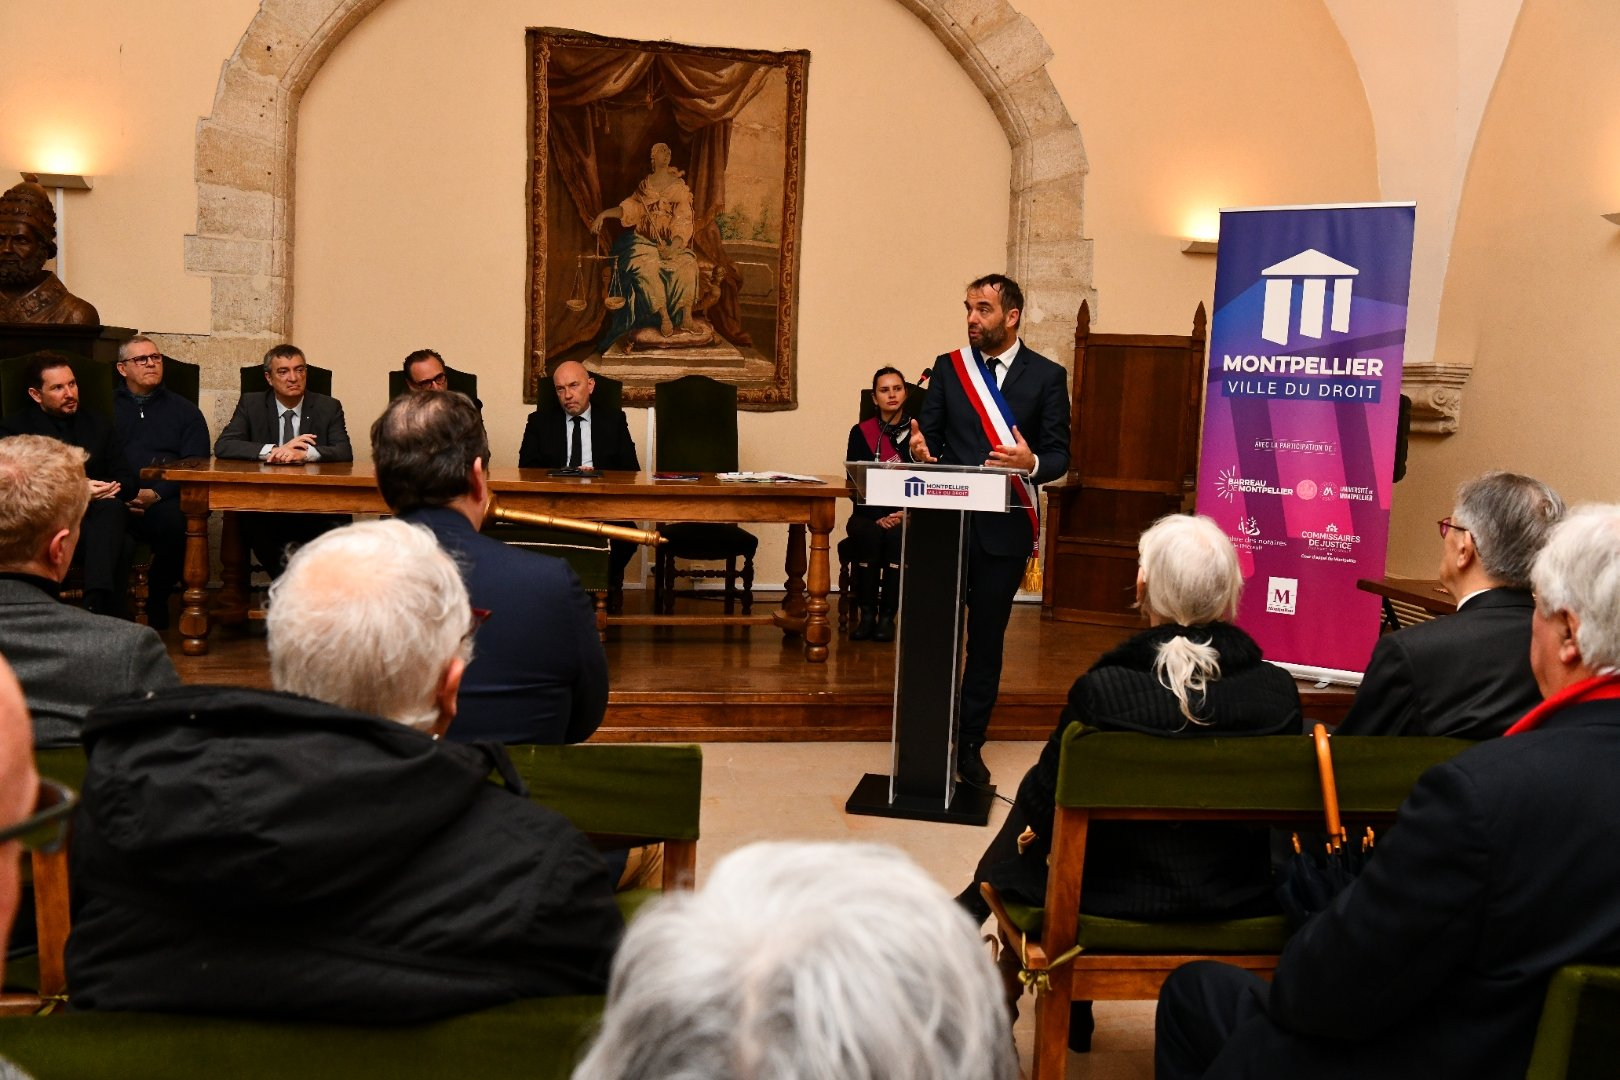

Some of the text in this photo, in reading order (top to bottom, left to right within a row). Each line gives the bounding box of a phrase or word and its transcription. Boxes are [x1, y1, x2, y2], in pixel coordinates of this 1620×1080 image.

[1223, 354, 1384, 377] MONTPELLIER
[1228, 380, 1376, 399] VILLE DU DROIT
[1280, 442, 1323, 451] PARTICIPATION
[1228, 478, 1266, 487] BARREAU
[1239, 486, 1294, 495] MONTPELLIER
[1340, 493, 1373, 501] MONTPELLIER
[1302, 531, 1360, 543] COMMISSAIRES
[1258, 538, 1287, 547] notaires
[1273, 588, 1290, 605] M
